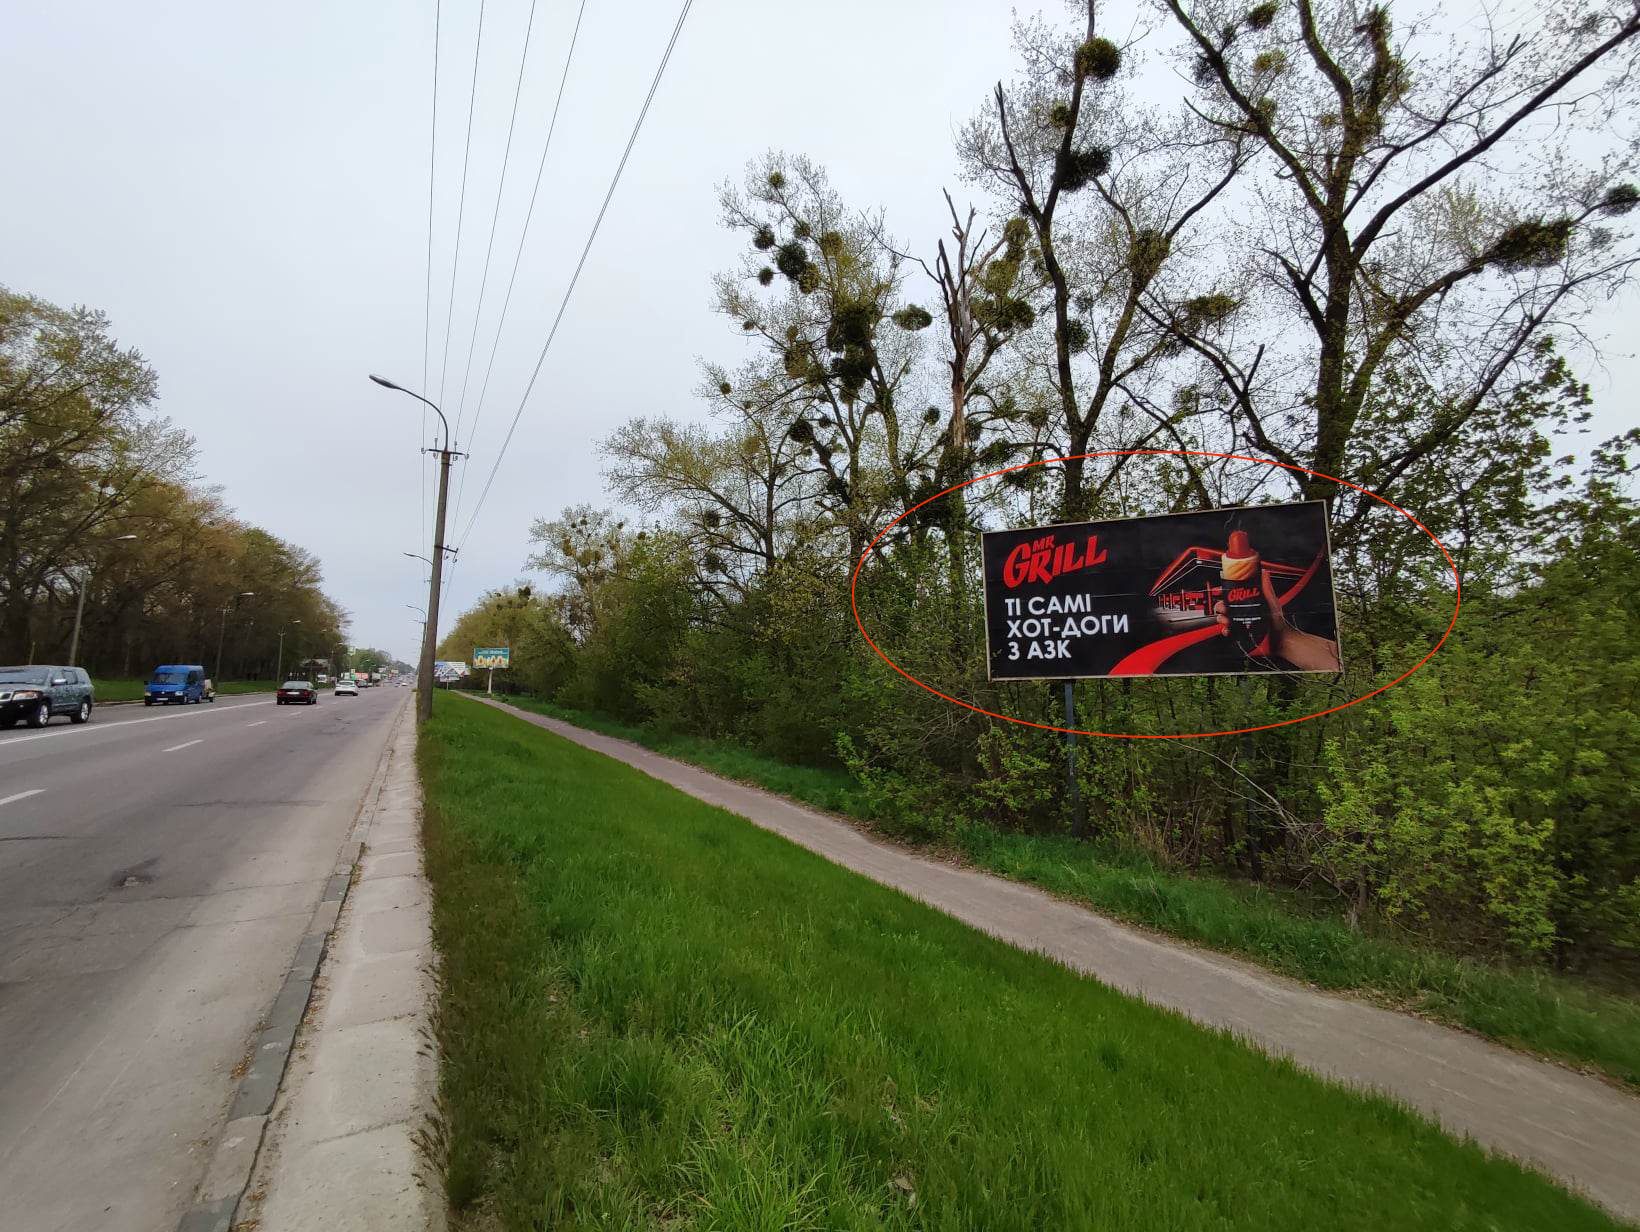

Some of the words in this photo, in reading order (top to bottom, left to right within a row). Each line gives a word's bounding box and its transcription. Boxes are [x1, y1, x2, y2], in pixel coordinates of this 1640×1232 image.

[1032, 535, 1055, 553] MR
[1003, 535, 1109, 588] GRILL
[1005, 597, 1022, 616] ТІ
[1027, 594, 1092, 615] САМІ
[1006, 614, 1129, 638] ХОТ-ДОГИ
[1027, 639, 1072, 660] АЗК
